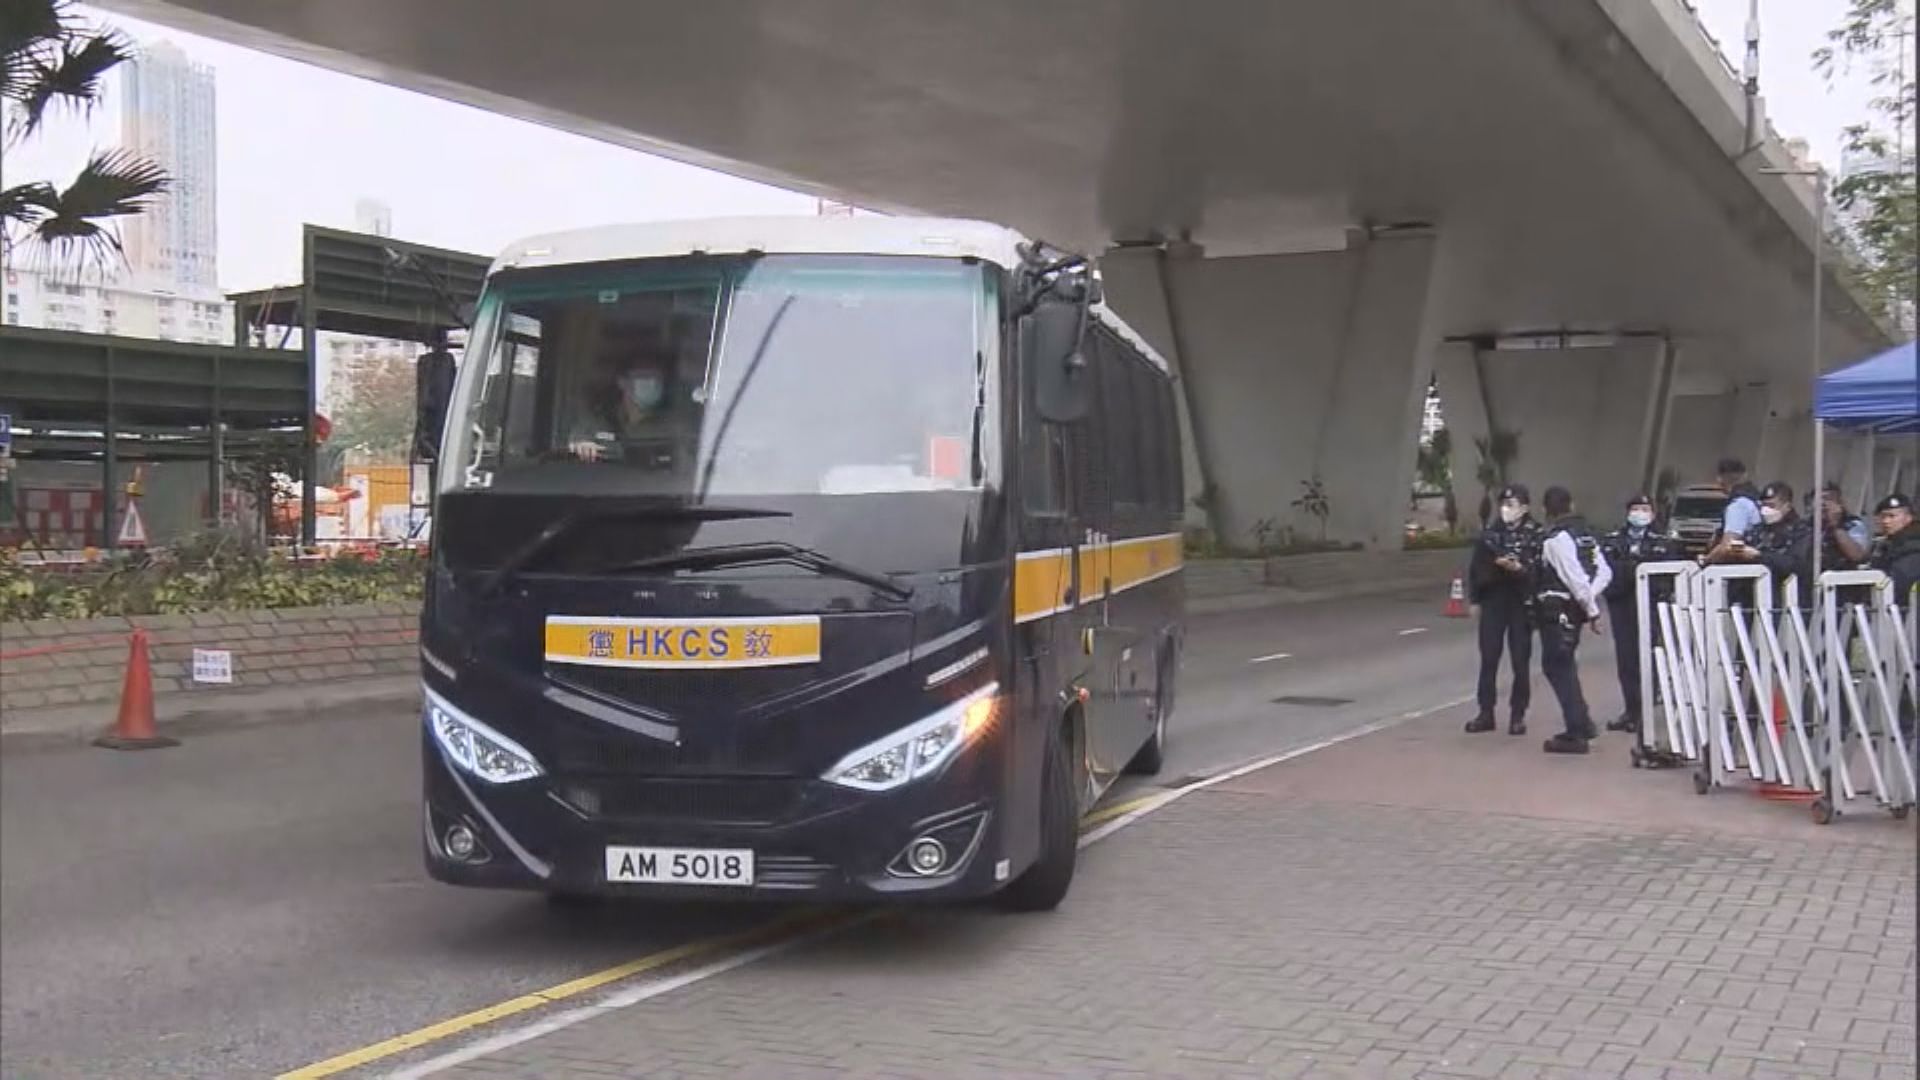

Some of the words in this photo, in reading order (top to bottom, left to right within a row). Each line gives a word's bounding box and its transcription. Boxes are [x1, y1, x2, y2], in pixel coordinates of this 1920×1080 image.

[588, 629, 614, 658] 懲
[628, 628, 730, 657] HKCS
[619, 852, 657, 878] AM
[671, 853, 742, 879] 5018
